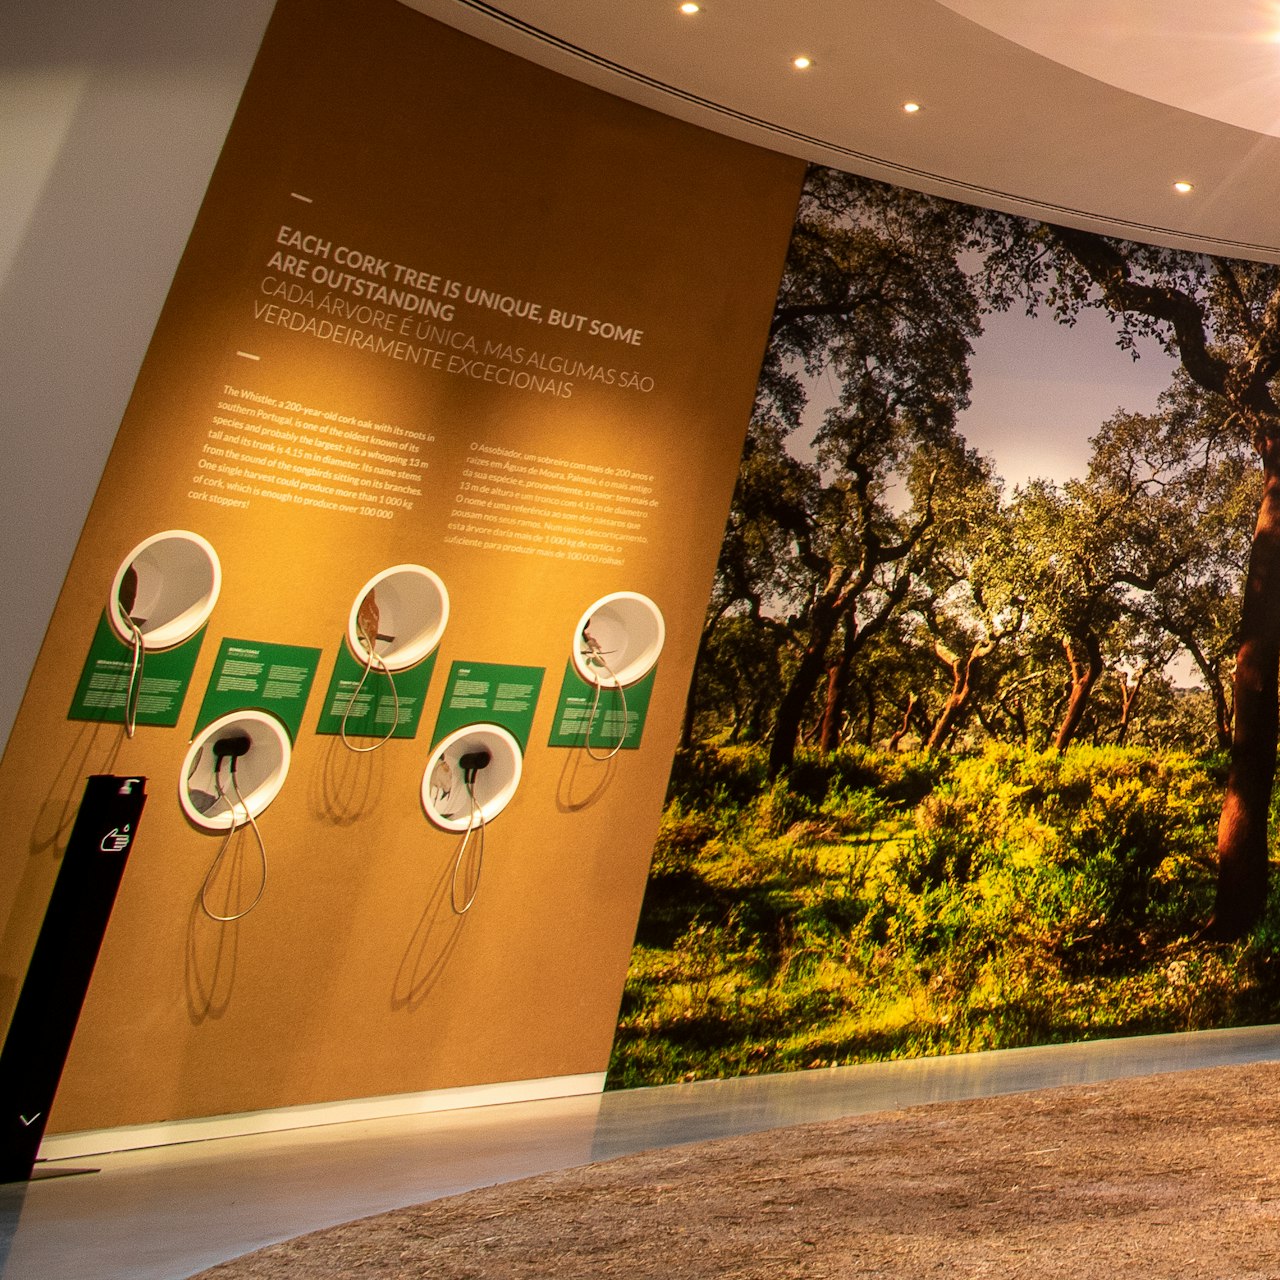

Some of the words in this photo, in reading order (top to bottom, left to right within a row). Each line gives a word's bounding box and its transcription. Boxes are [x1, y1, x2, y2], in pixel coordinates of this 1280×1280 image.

[268, 251, 309, 278] ARE
[312, 266, 455, 321] OUTSTANDING
[277, 226, 331, 258] EACH
[334, 246, 390, 278] CORK
[394, 264, 441, 292] TREE
[443, 280, 462, 298] IS
[465, 286, 542, 324] UNIQUE,
[548, 309, 587, 331] BUT
[589, 320, 644, 345] SOME
[254, 300, 445, 369] VERDADEIRAMENTE
[447, 356, 574, 398] EXCECIONAIS
[261, 277, 314, 308] CADA
[317, 292, 397, 332] ÁRVORE
[400, 316, 413, 336] É
[416, 320, 478, 355] ÚNICA,
[484, 340, 525, 364] MAS
[526, 352, 616, 384] ALGUMAS
[618, 371, 654, 392] SÃO
[218, 402, 256, 416] southern
[295, 419, 302, 428] is
[303, 423, 319, 431] one
[330, 428, 344, 437] the
[344, 431, 370, 442] oldest
[370, 436, 398, 448] known
[409, 443, 420, 453] its
[224, 385, 240, 397] The
[241, 390, 277, 407] Whistler,
[285, 401, 338, 421] 200-year-old
[338, 416, 357, 425] cork
[358, 420, 373, 429] oak
[374, 424, 393, 433] with
[394, 426, 404, 435] its
[405, 431, 426, 440] roots
[427, 434, 435, 442] in
[209, 430, 224, 440] tall
[223, 435, 240, 444] and
[241, 437, 252, 446] its
[253, 440, 276, 452] trunk
[277, 445, 283, 454] is
[313, 453, 322, 462] in
[322, 456, 360, 470] diameter.
[362, 463, 373, 472] Its
[374, 467, 397, 477] name
[398, 471, 422, 482] stems
[213, 416, 244, 429] species
[245, 424, 262, 433] and
[261, 428, 299, 442] probably
[300, 436, 314, 445] the
[346, 445, 352, 453] it
[353, 447, 361, 455] is
[368, 451, 408, 466] whopping
[410, 458, 420, 467] 13
[470, 442, 479, 451] O
[538, 457, 569, 467] sobreiro
[615, 469, 631, 478] 200
[199, 459, 217, 471] One
[218, 464, 243, 476] single
[244, 469, 276, 483] harvest
[276, 478, 300, 487] could
[300, 483, 335, 494] produce
[336, 489, 358, 498] more
[359, 492, 378, 502] than
[380, 496, 384, 504] 1
[386, 497, 402, 506] 000
[403, 499, 414, 510] kg
[203, 444, 224, 456] from
[226, 450, 240, 460] the
[241, 455, 267, 465] sound
[278, 461, 292, 471] the
[293, 466, 332, 479] songbirds
[333, 473, 360, 486] sitting
[373, 480, 383, 489] its
[384, 482, 422, 496] branches.
[460, 482, 471, 490] 13
[480, 486, 490, 494] de
[491, 488, 514, 497] altura
[535, 495, 560, 505] tronco
[463, 469, 473, 477] da
[503, 461, 527, 473] Águas
[528, 467, 538, 475] de
[629, 485, 653, 494] antigo
[188, 491, 208, 501] cork
[209, 495, 250, 509] stoppers!
[193, 475, 204, 483] of
[227, 483, 252, 494] which
[253, 487, 260, 495] is
[261, 490, 293, 502] enough
[294, 495, 303, 503] to
[304, 498, 338, 510] produce
[339, 505, 358, 513] over
[360, 507, 376, 516] 100
[377, 510, 394, 519] 000
[456, 494, 464, 503] O
[464, 498, 486, 507] nome
